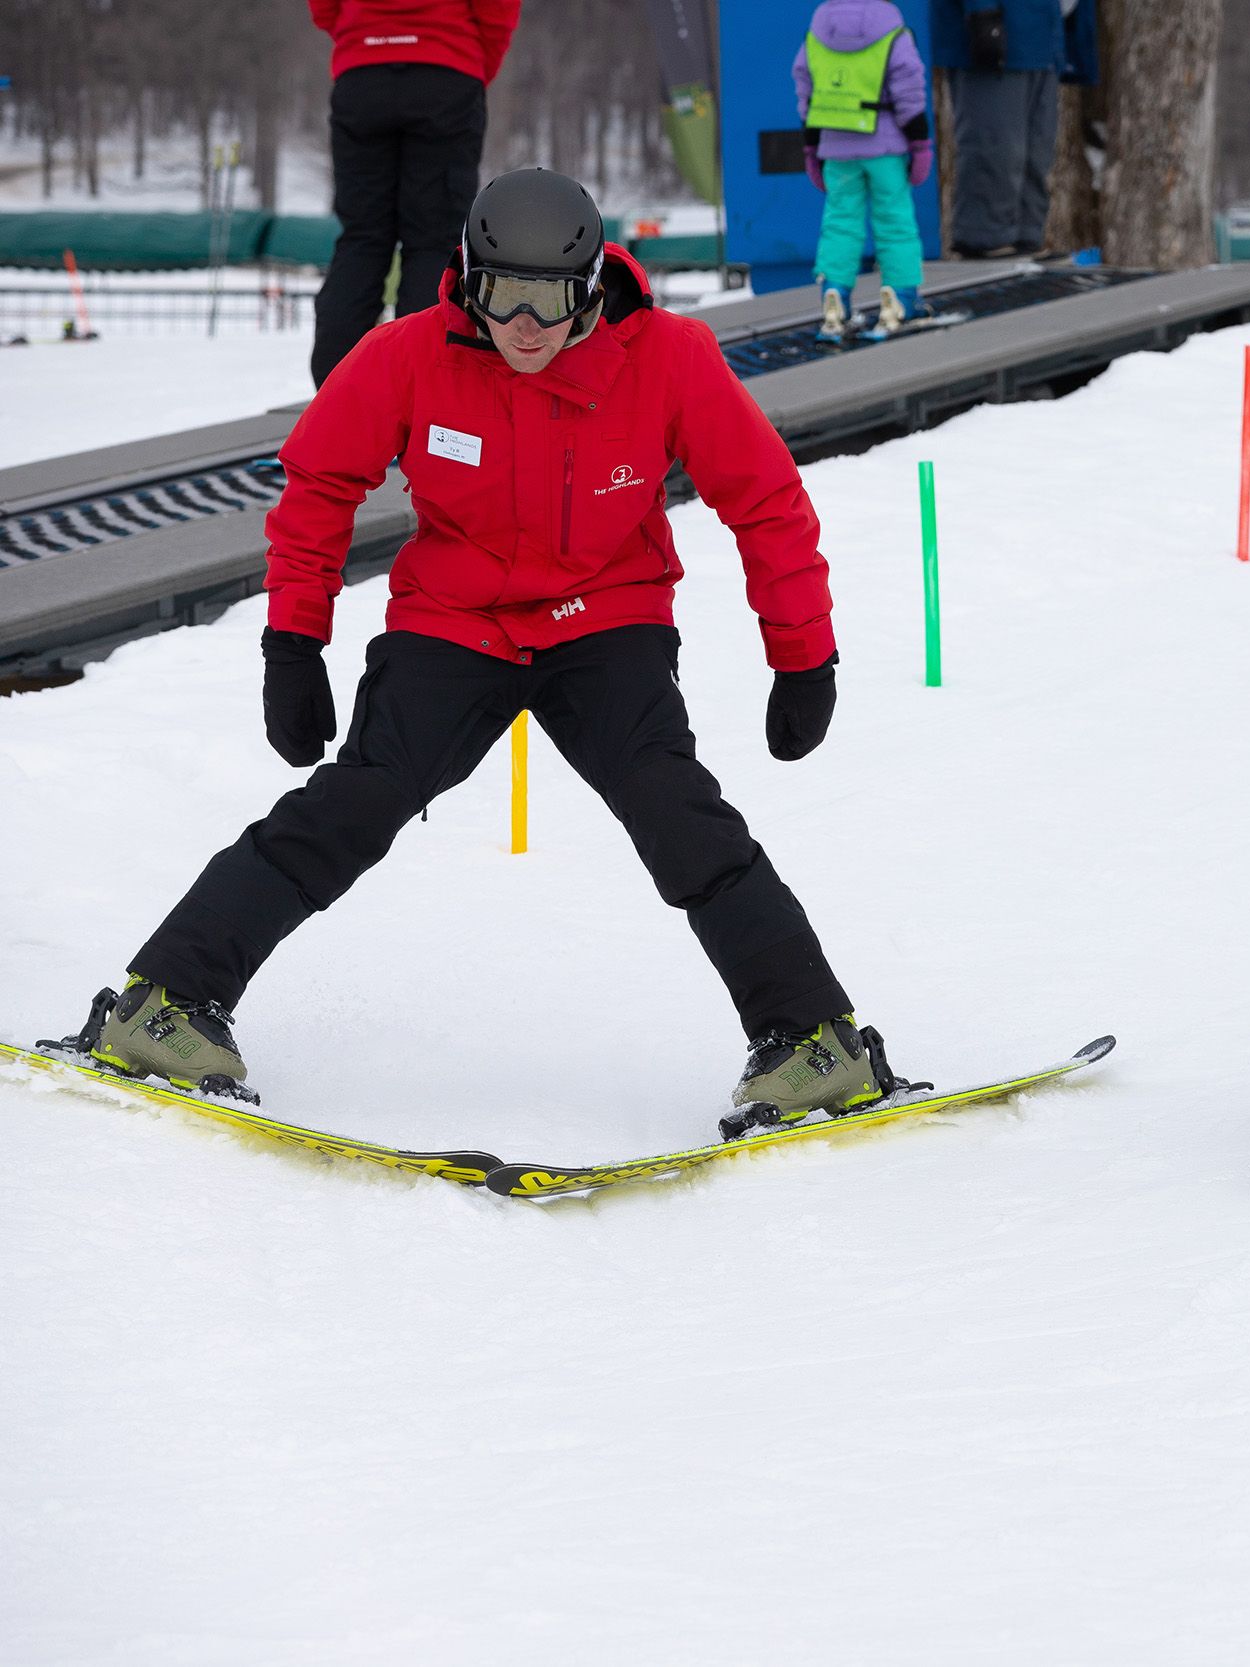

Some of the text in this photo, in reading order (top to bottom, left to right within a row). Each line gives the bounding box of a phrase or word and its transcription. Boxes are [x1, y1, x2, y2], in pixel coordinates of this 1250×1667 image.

[594, 478, 645, 496] THE HIGHLANDS
[551, 596, 586, 621] HH
